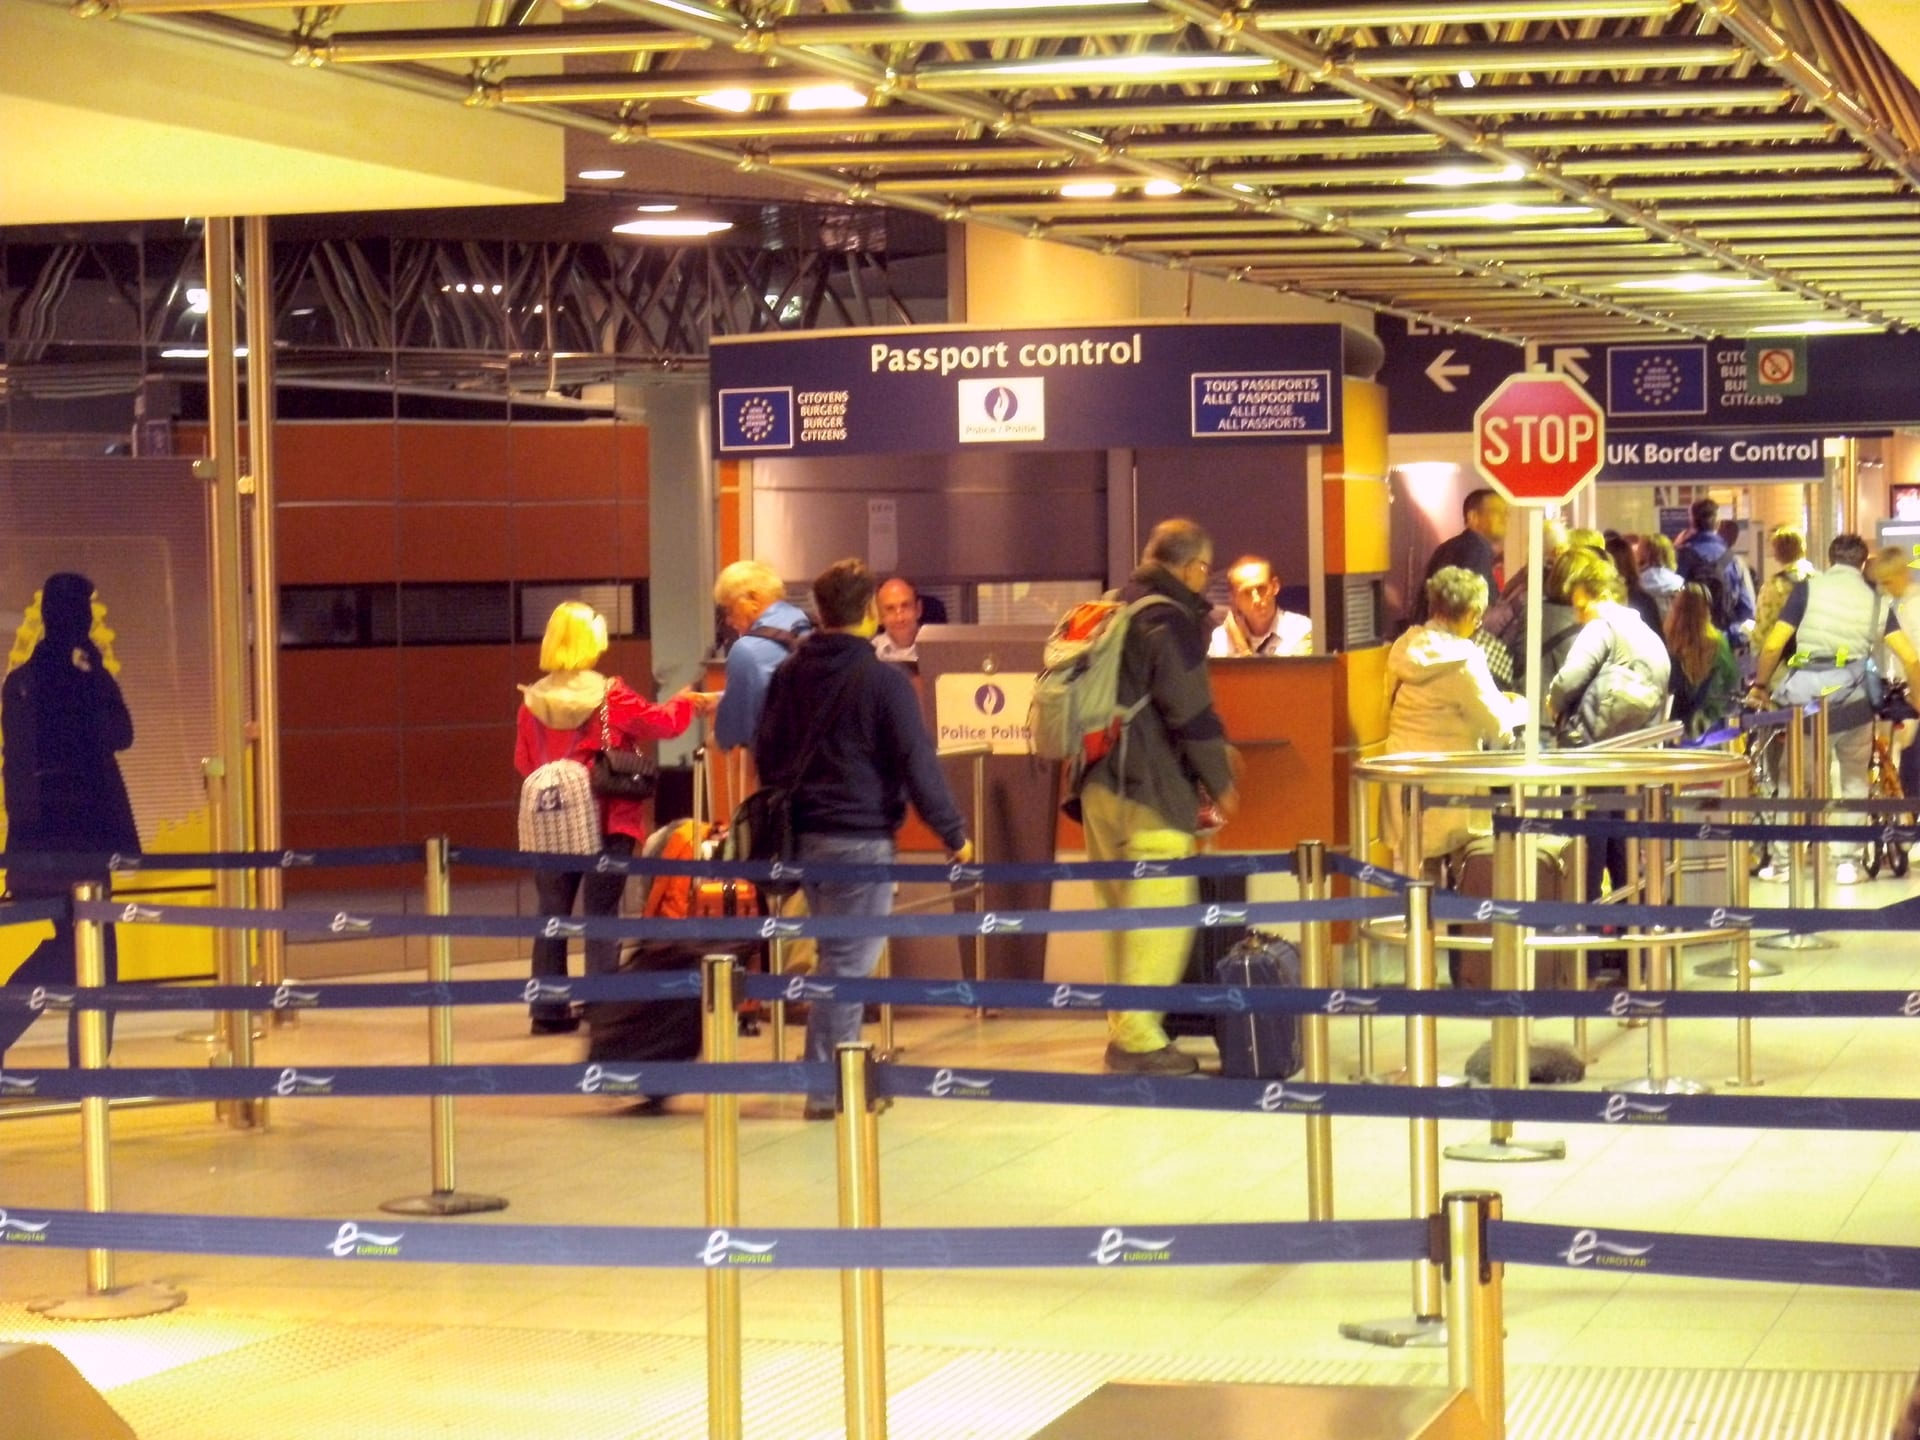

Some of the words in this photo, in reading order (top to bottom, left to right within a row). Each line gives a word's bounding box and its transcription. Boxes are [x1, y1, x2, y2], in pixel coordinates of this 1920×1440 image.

[872, 341, 1009, 376] Passport
[1019, 333, 1142, 367] control
[1203, 379, 1239, 393] TOUS
[1241, 377, 1320, 391] PASSEPORTS
[797, 390, 850, 405] CITOYENS
[1202, 392, 1233, 405] ALLE
[1237, 391, 1321, 405] PASPOORTEN
[800, 403, 848, 417] BURGERS
[1229, 405, 1258, 417] ALLE
[1259, 404, 1294, 416] PASSE
[803, 416, 844, 429] BURGER
[1217, 418, 1240, 430] ALL
[1240, 416, 1307, 430] PASSPORTS
[801, 428, 848, 441] CITIZENS
[1484, 415, 1595, 466] STOP
[1607, 443, 1641, 466] UK
[1644, 440, 1723, 464] Border
[1729, 439, 1818, 463] Control
[940, 724, 986, 740] Police
[728, 1253, 774, 1265] EUROSTAR
[1123, 1250, 1171, 1262] EUROSTAR
[1595, 1254, 1648, 1268] EUROSTAR
